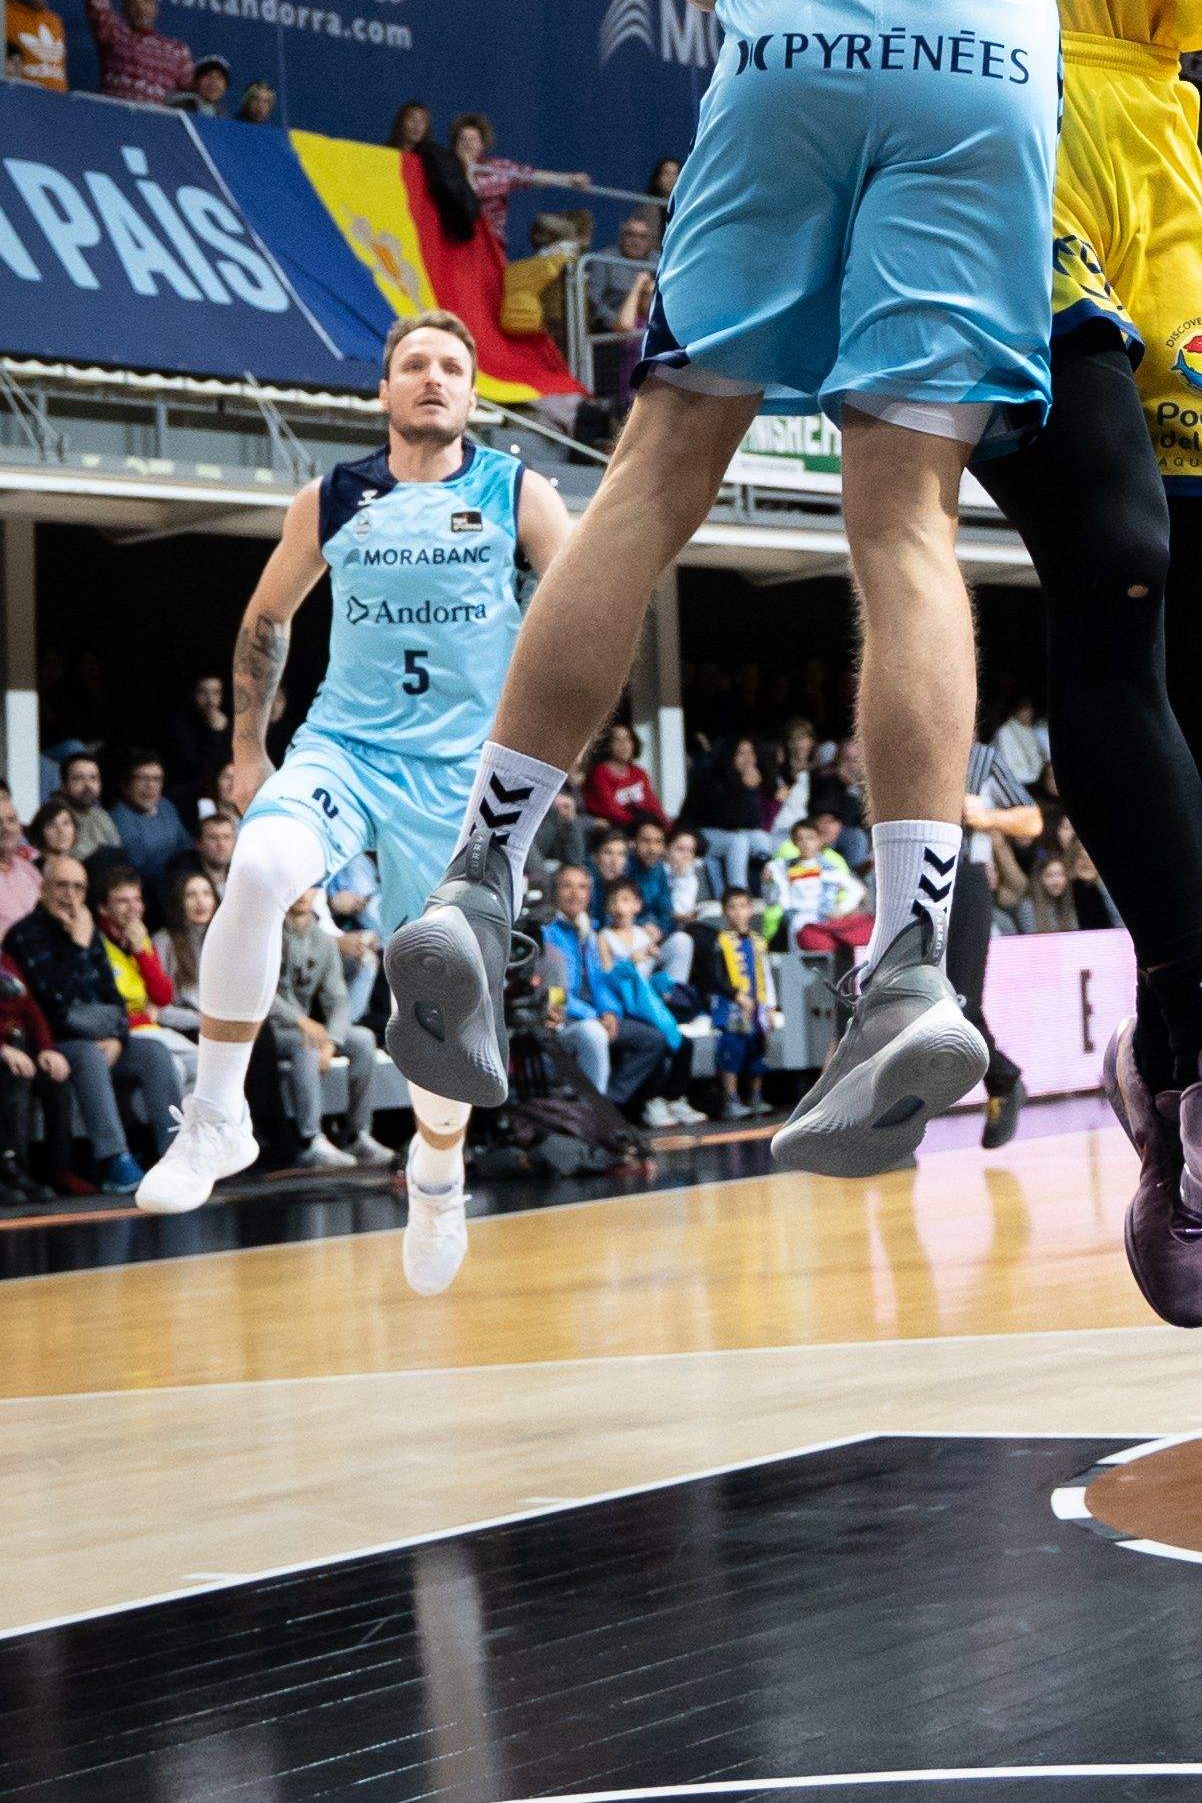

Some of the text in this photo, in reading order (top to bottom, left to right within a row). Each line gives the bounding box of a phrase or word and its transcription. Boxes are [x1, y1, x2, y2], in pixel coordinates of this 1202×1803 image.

[363, 546, 491, 566] MORABANC
[375, 599, 487, 625] Andorra
[402, 649, 431, 696] 5
